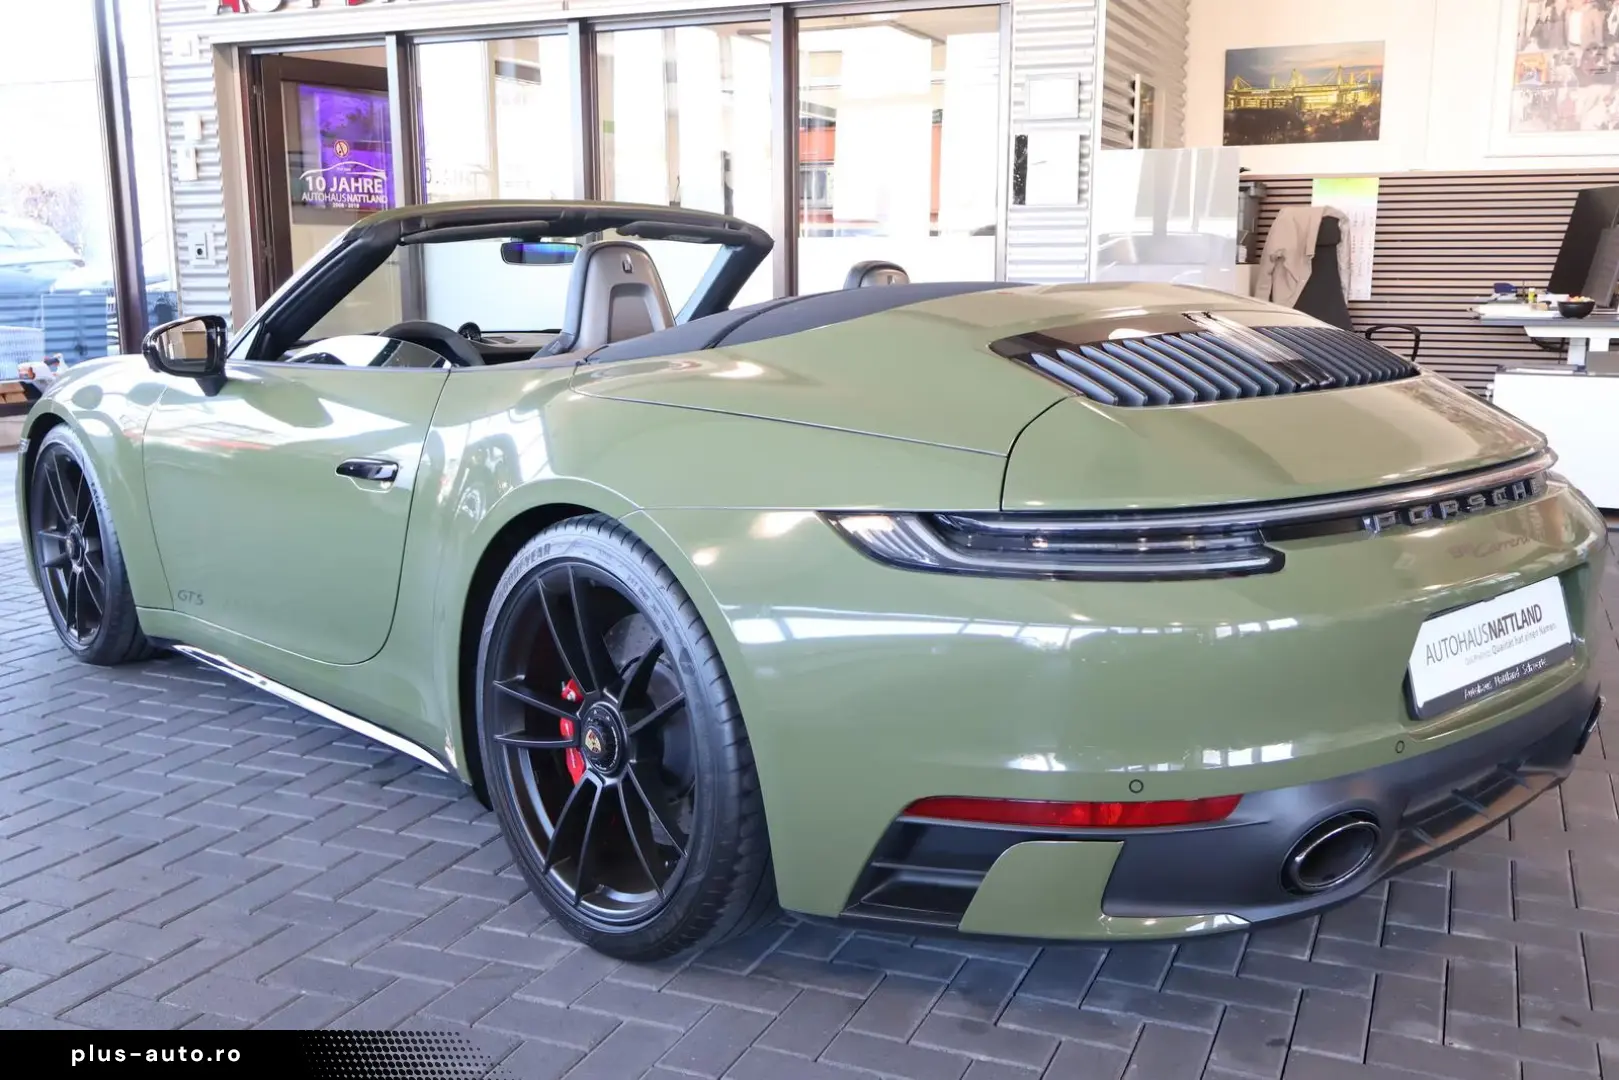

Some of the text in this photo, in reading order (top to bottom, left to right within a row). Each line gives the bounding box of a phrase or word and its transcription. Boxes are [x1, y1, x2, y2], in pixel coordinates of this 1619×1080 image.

[305, 176, 384, 193] 10 JAHRE
[302, 192, 388, 204] AUTOHAUSNATTLAND
[1363, 478, 1540, 533] PORSCHE
[178, 589, 204, 606] GTS
[1426, 603, 1543, 666] AUTOHAUSNATTLAND
